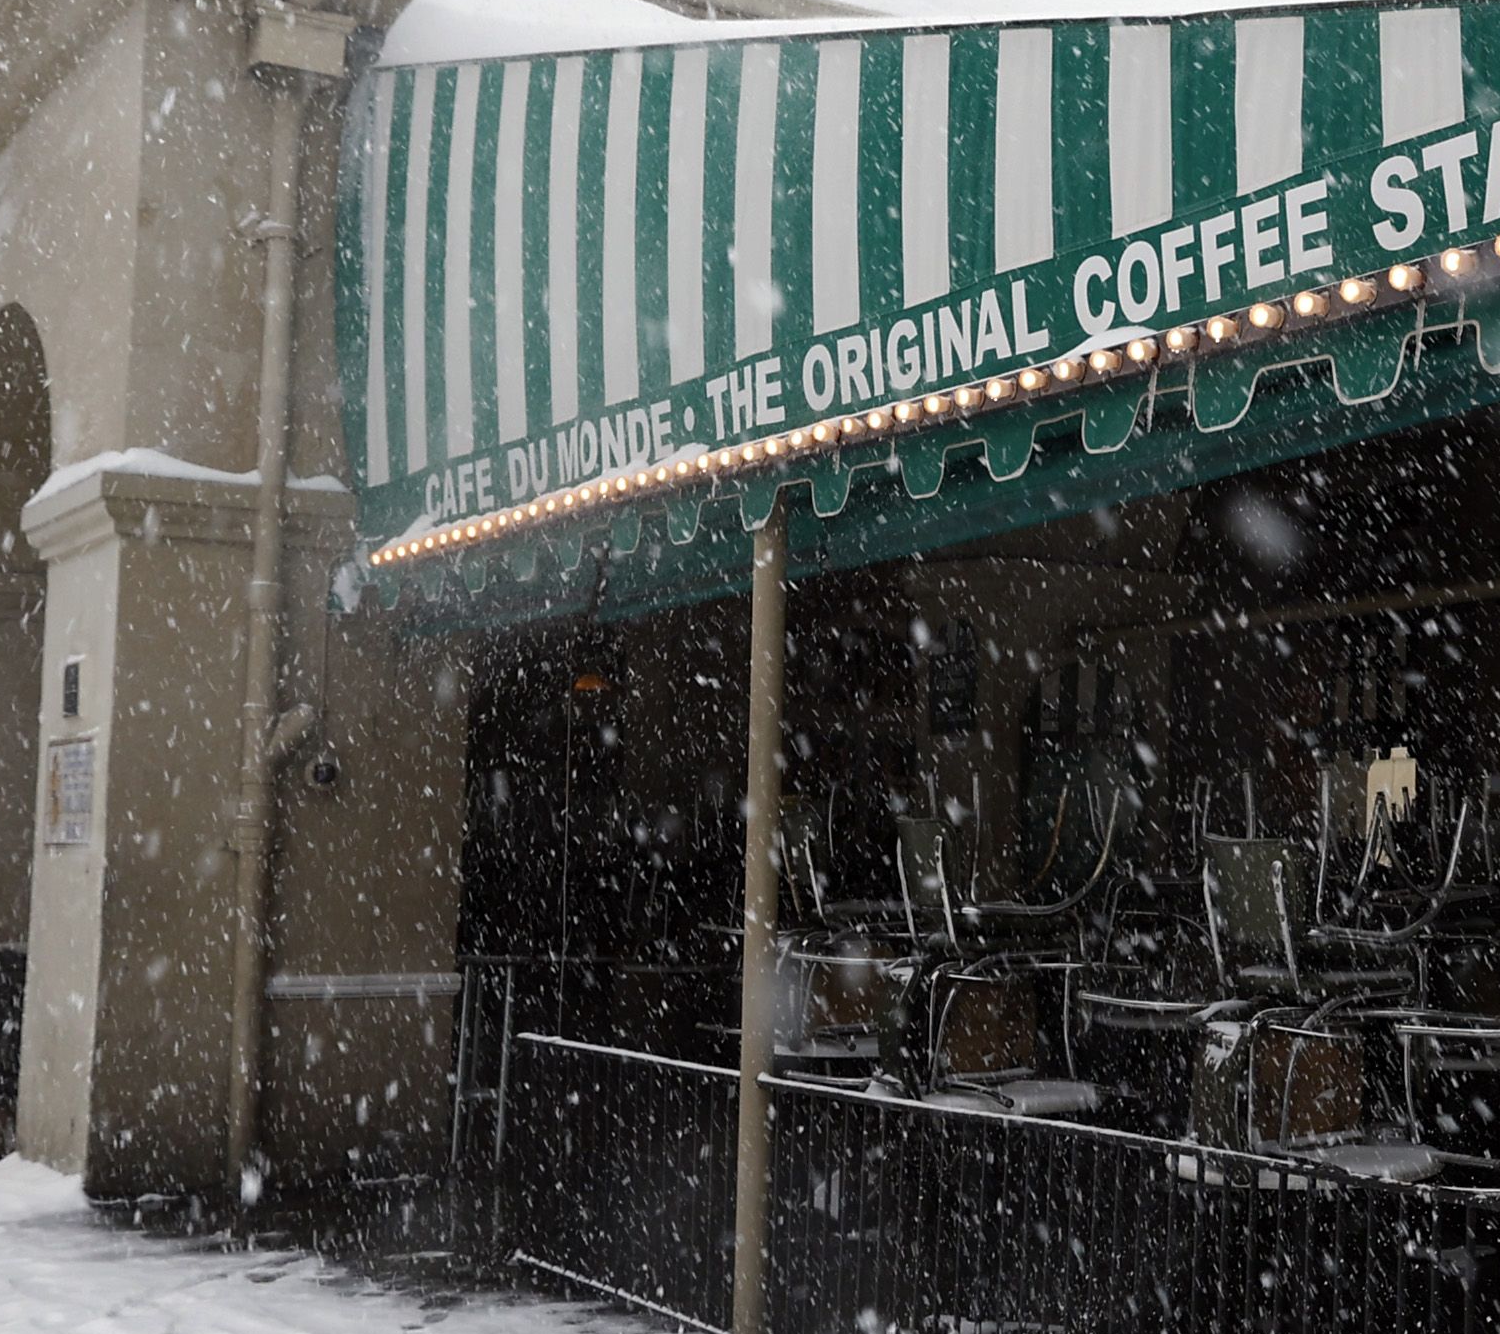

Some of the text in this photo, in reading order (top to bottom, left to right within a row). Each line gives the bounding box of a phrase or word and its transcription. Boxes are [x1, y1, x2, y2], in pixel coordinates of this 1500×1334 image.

[425, 460, 495, 519] CAFE
[508, 443, 549, 497] DU
[557, 402, 673, 489] MONDE
[706, 357, 786, 441] THE
[802, 279, 1049, 411] ORIGINAL
[1074, 179, 1334, 337] COFFEE
